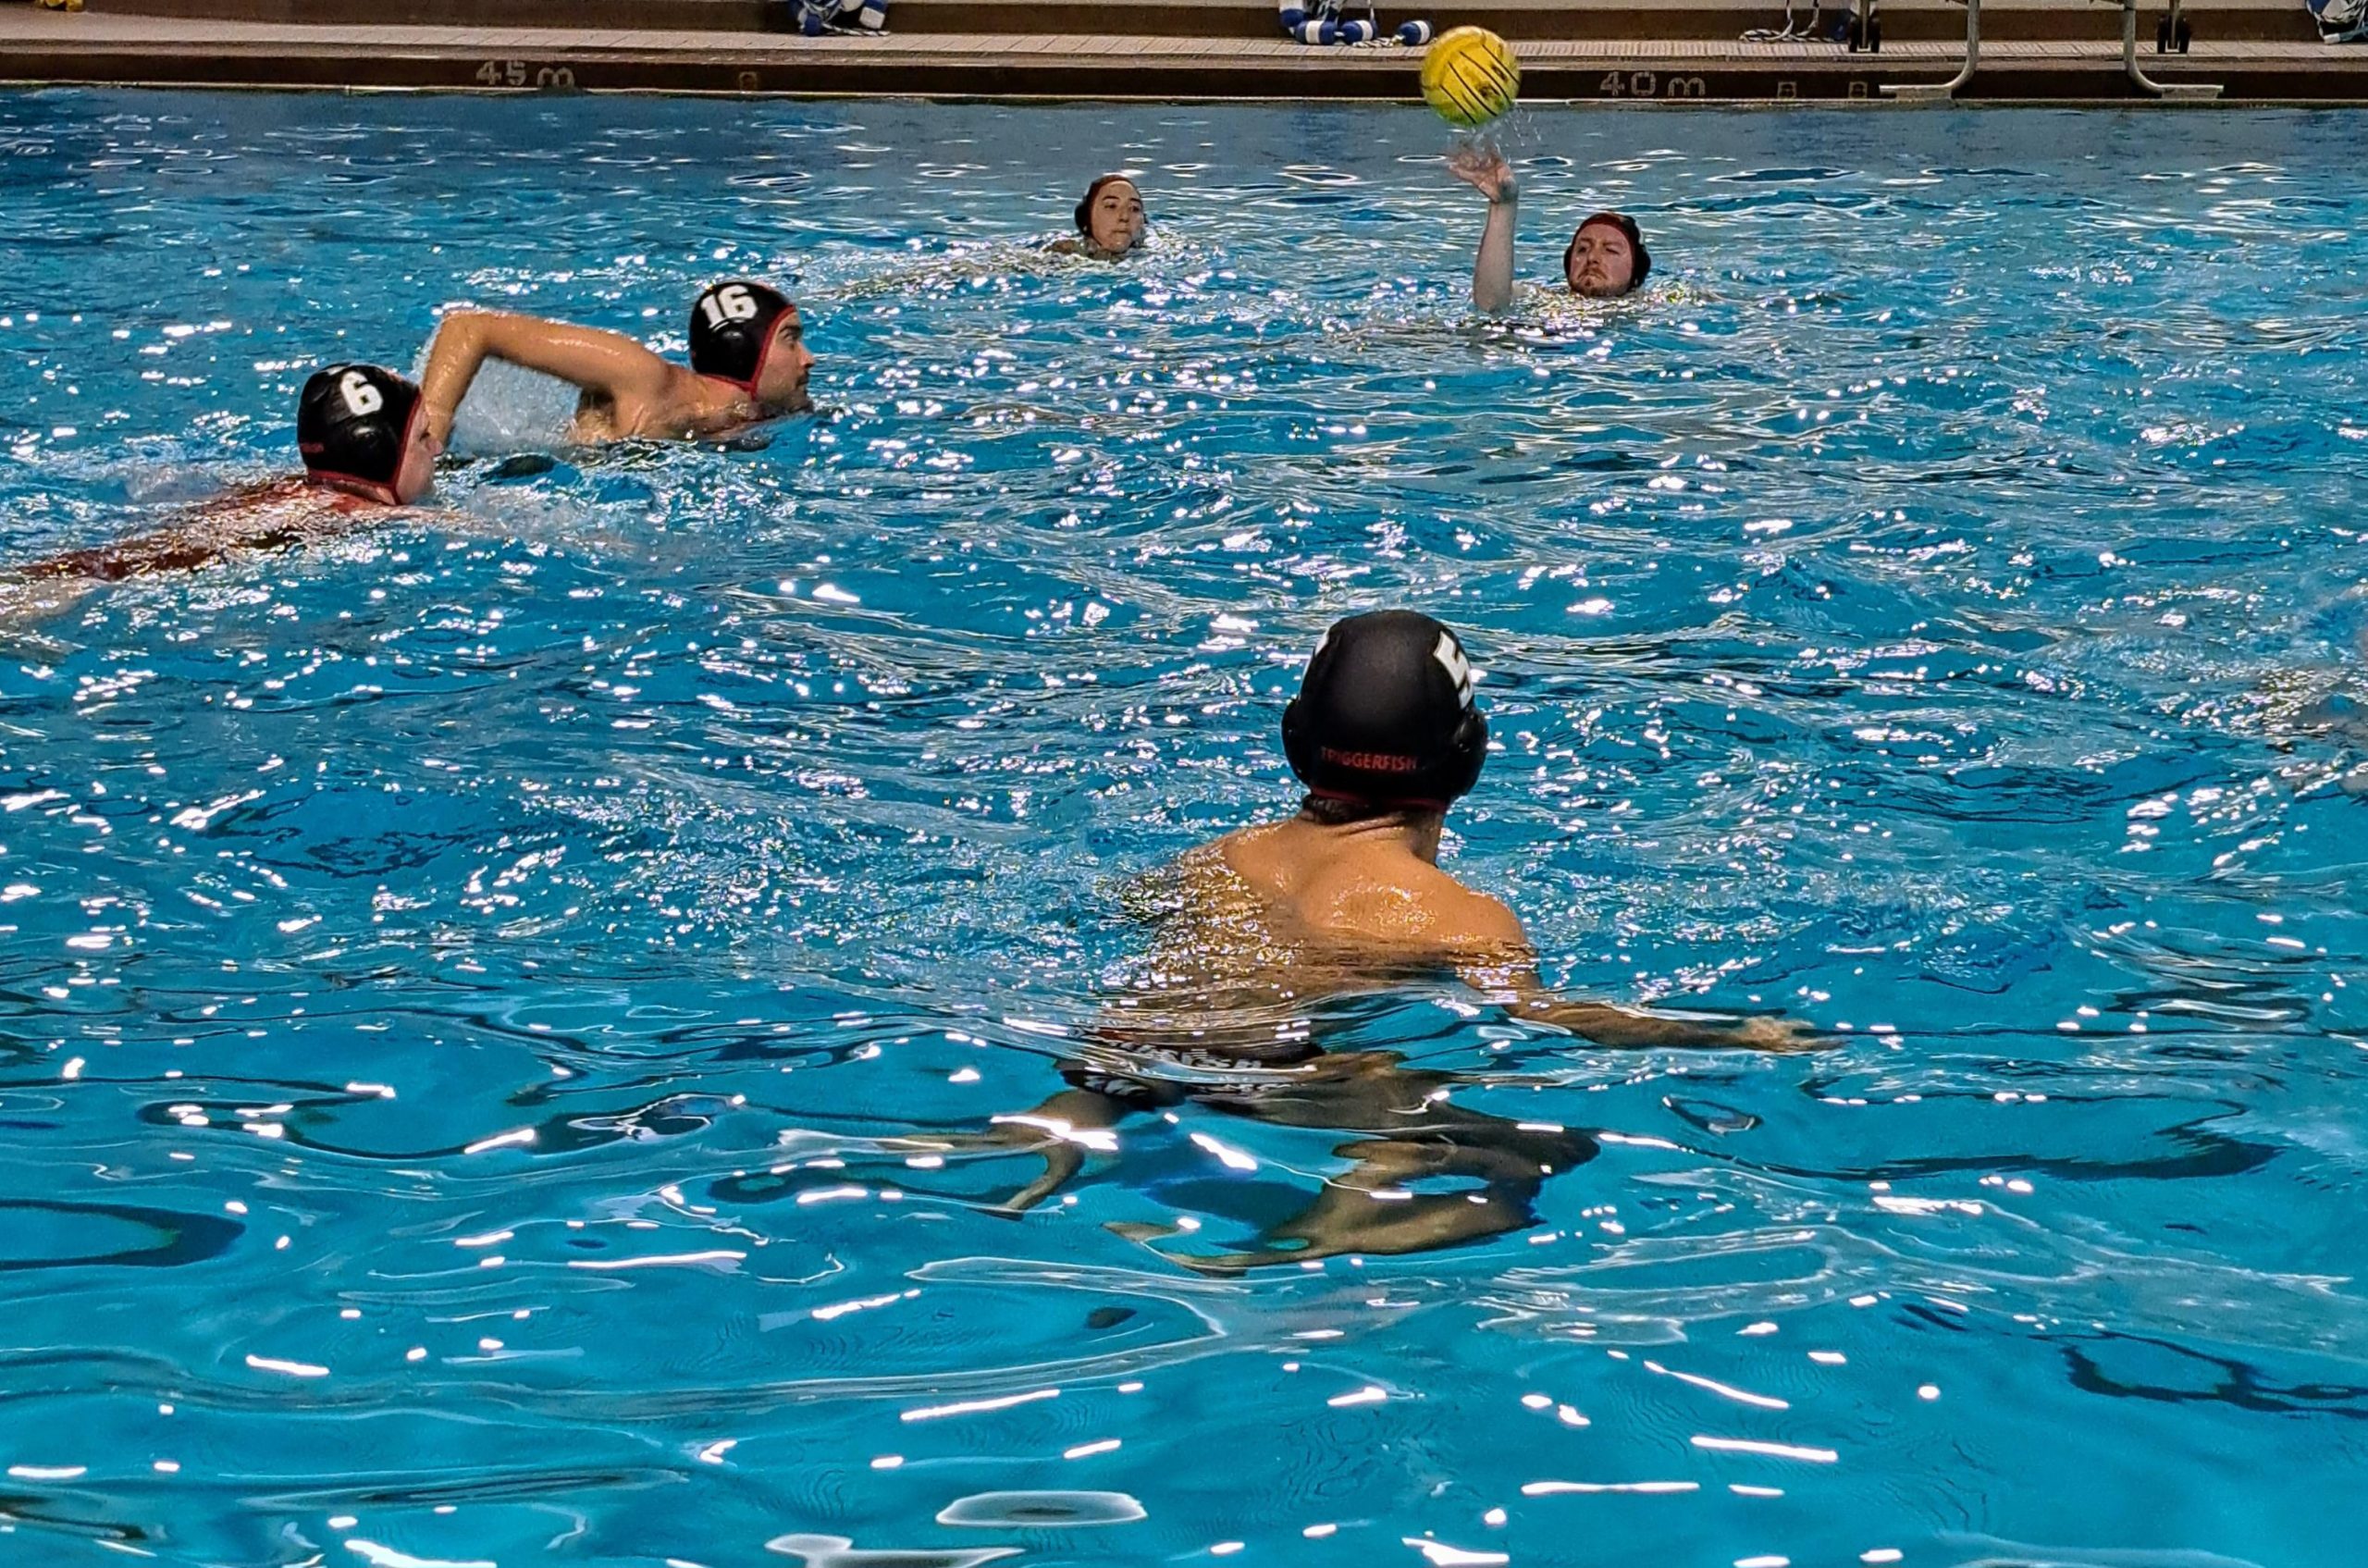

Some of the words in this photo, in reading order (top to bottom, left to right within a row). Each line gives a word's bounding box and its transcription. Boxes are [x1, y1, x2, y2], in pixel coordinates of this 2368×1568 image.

[475, 60, 526, 86] 45
[537, 67, 574, 88] m
[1600, 71, 1656, 96] 40
[1668, 77, 1706, 96] m
[700, 284, 758, 329] 16
[340, 371, 384, 416] 6
[1320, 745, 1419, 772] TRIGGERFISH
